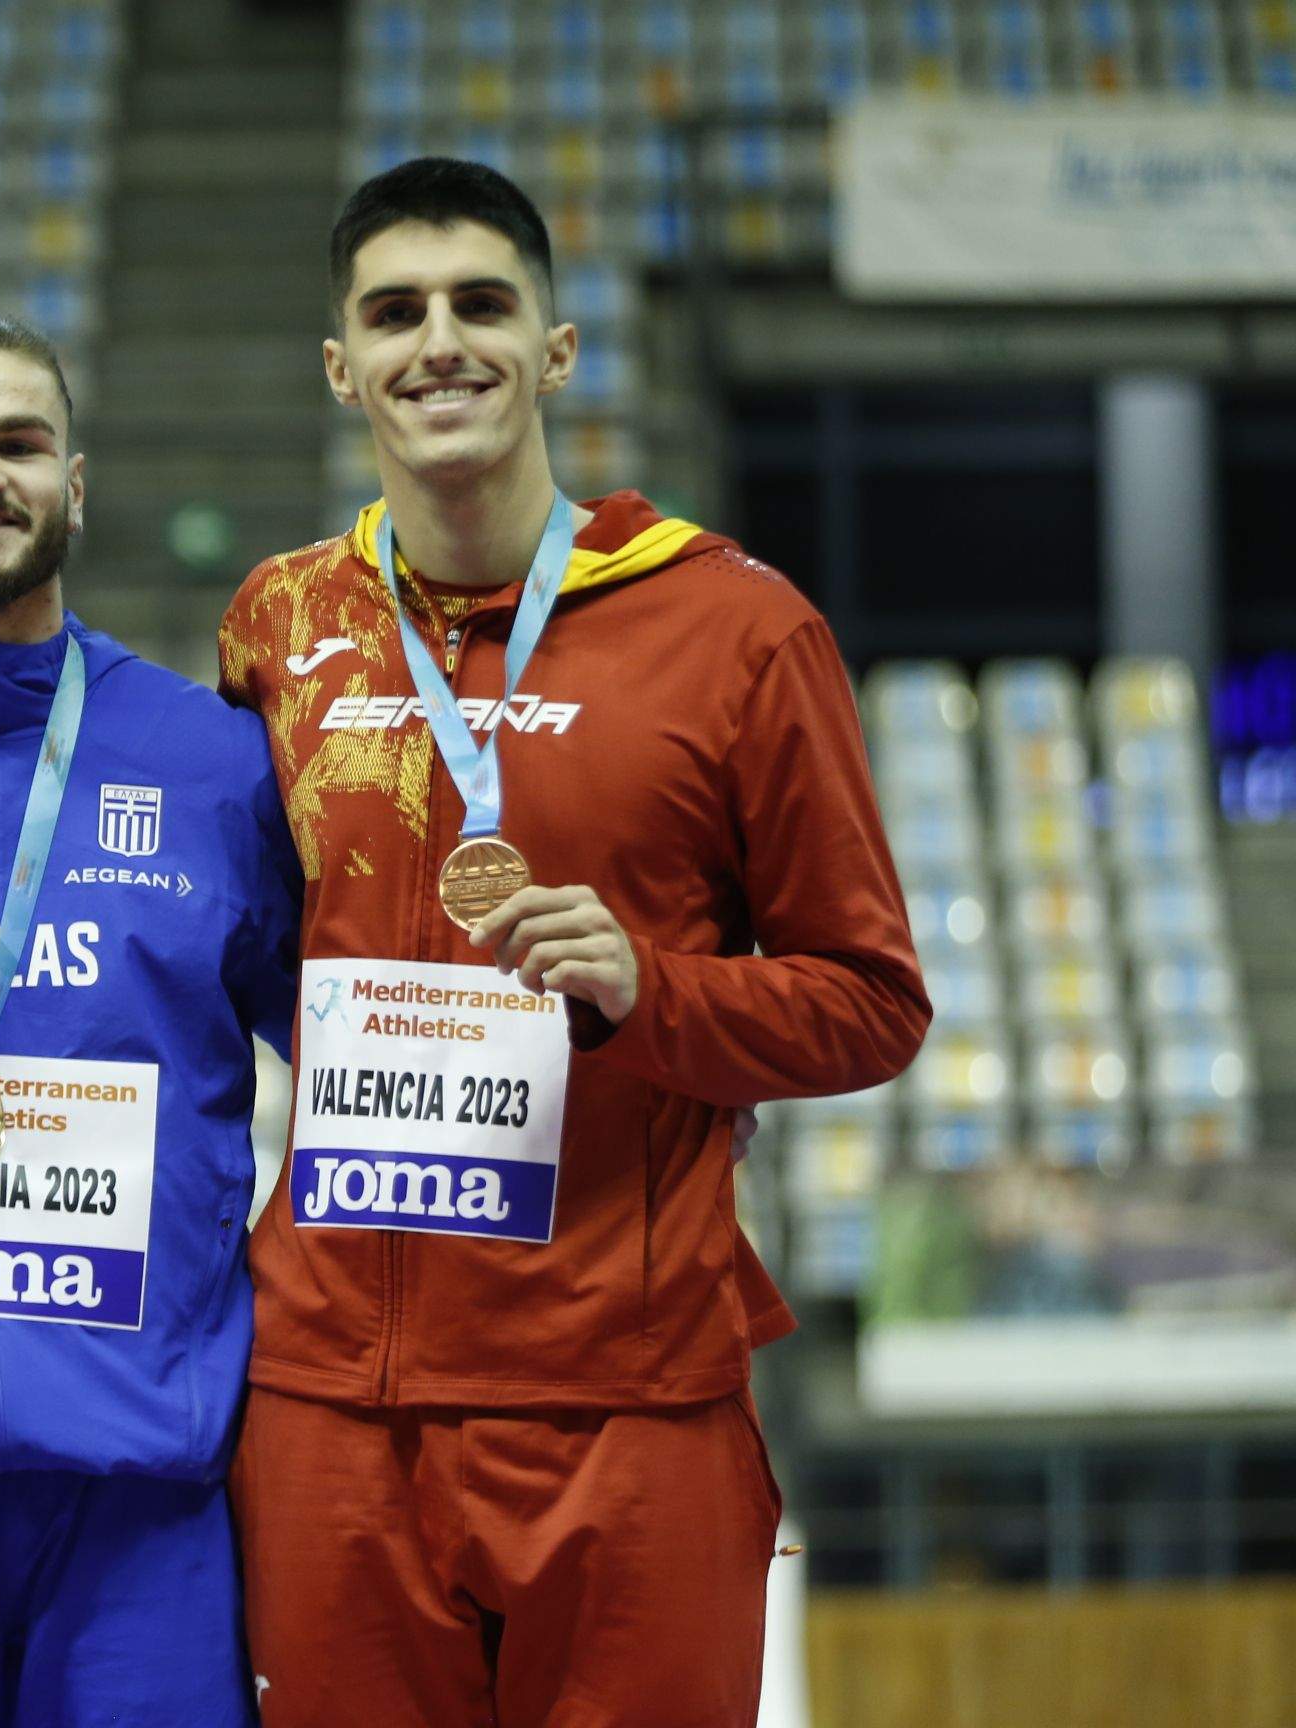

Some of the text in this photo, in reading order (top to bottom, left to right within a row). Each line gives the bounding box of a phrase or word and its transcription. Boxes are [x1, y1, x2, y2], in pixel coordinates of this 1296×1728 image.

[64, 867, 170, 890] AEGEAN
[352, 978, 556, 1014] Mediterranean
[363, 1013, 485, 1042] Athletics
[311, 1067, 529, 1128] VALENCIA 2023
[43, 1165, 117, 1216] 2023
